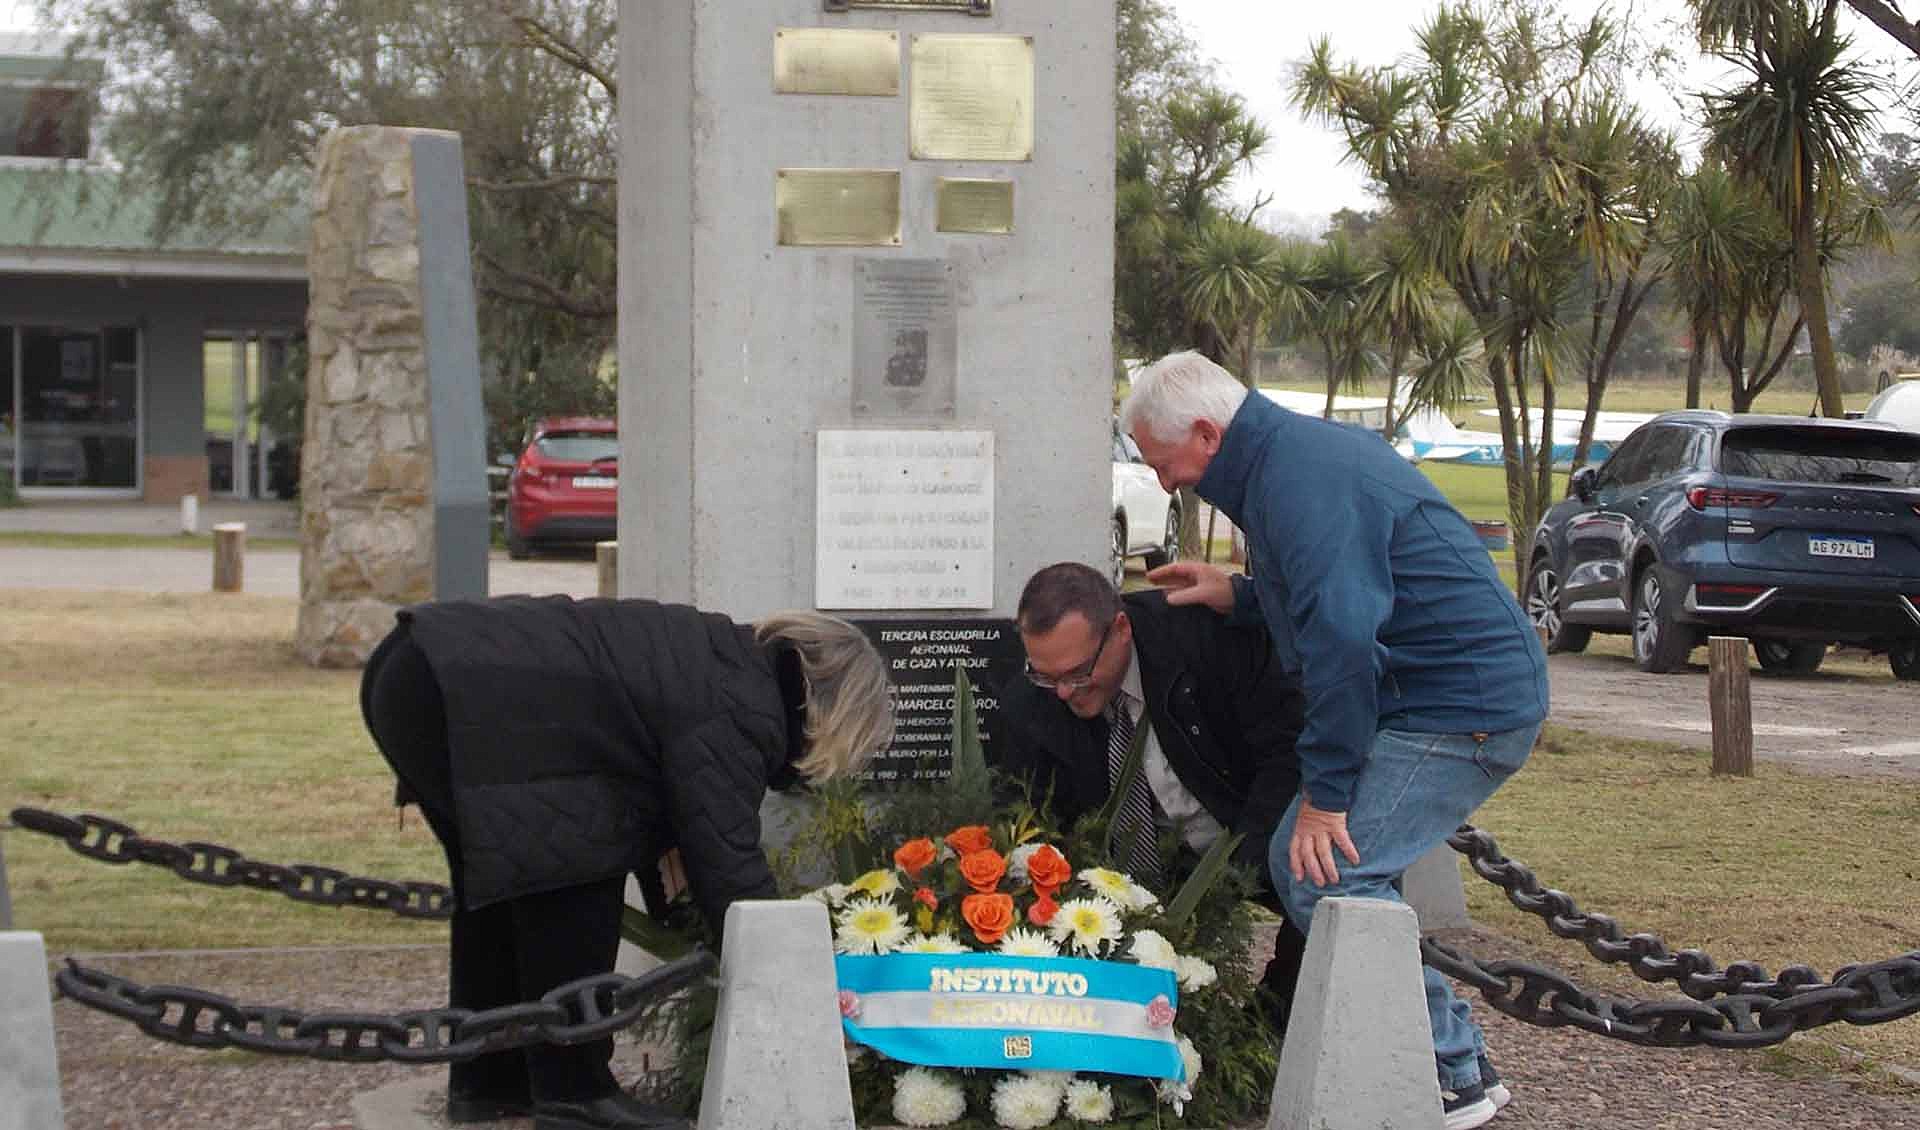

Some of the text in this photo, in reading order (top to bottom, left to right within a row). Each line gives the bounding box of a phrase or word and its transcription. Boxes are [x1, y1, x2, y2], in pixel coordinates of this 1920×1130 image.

[1831, 543, 1853, 554] 974
[881, 630, 1001, 641] TERCERA ESCUADRILLA
[910, 645, 973, 655] AERONAVAL
[893, 658, 992, 669] DE CAZA Y ATAQUE
[929, 967, 1089, 997] INSTITUTO
[928, 1000, 1104, 1028] AERONAVAL
